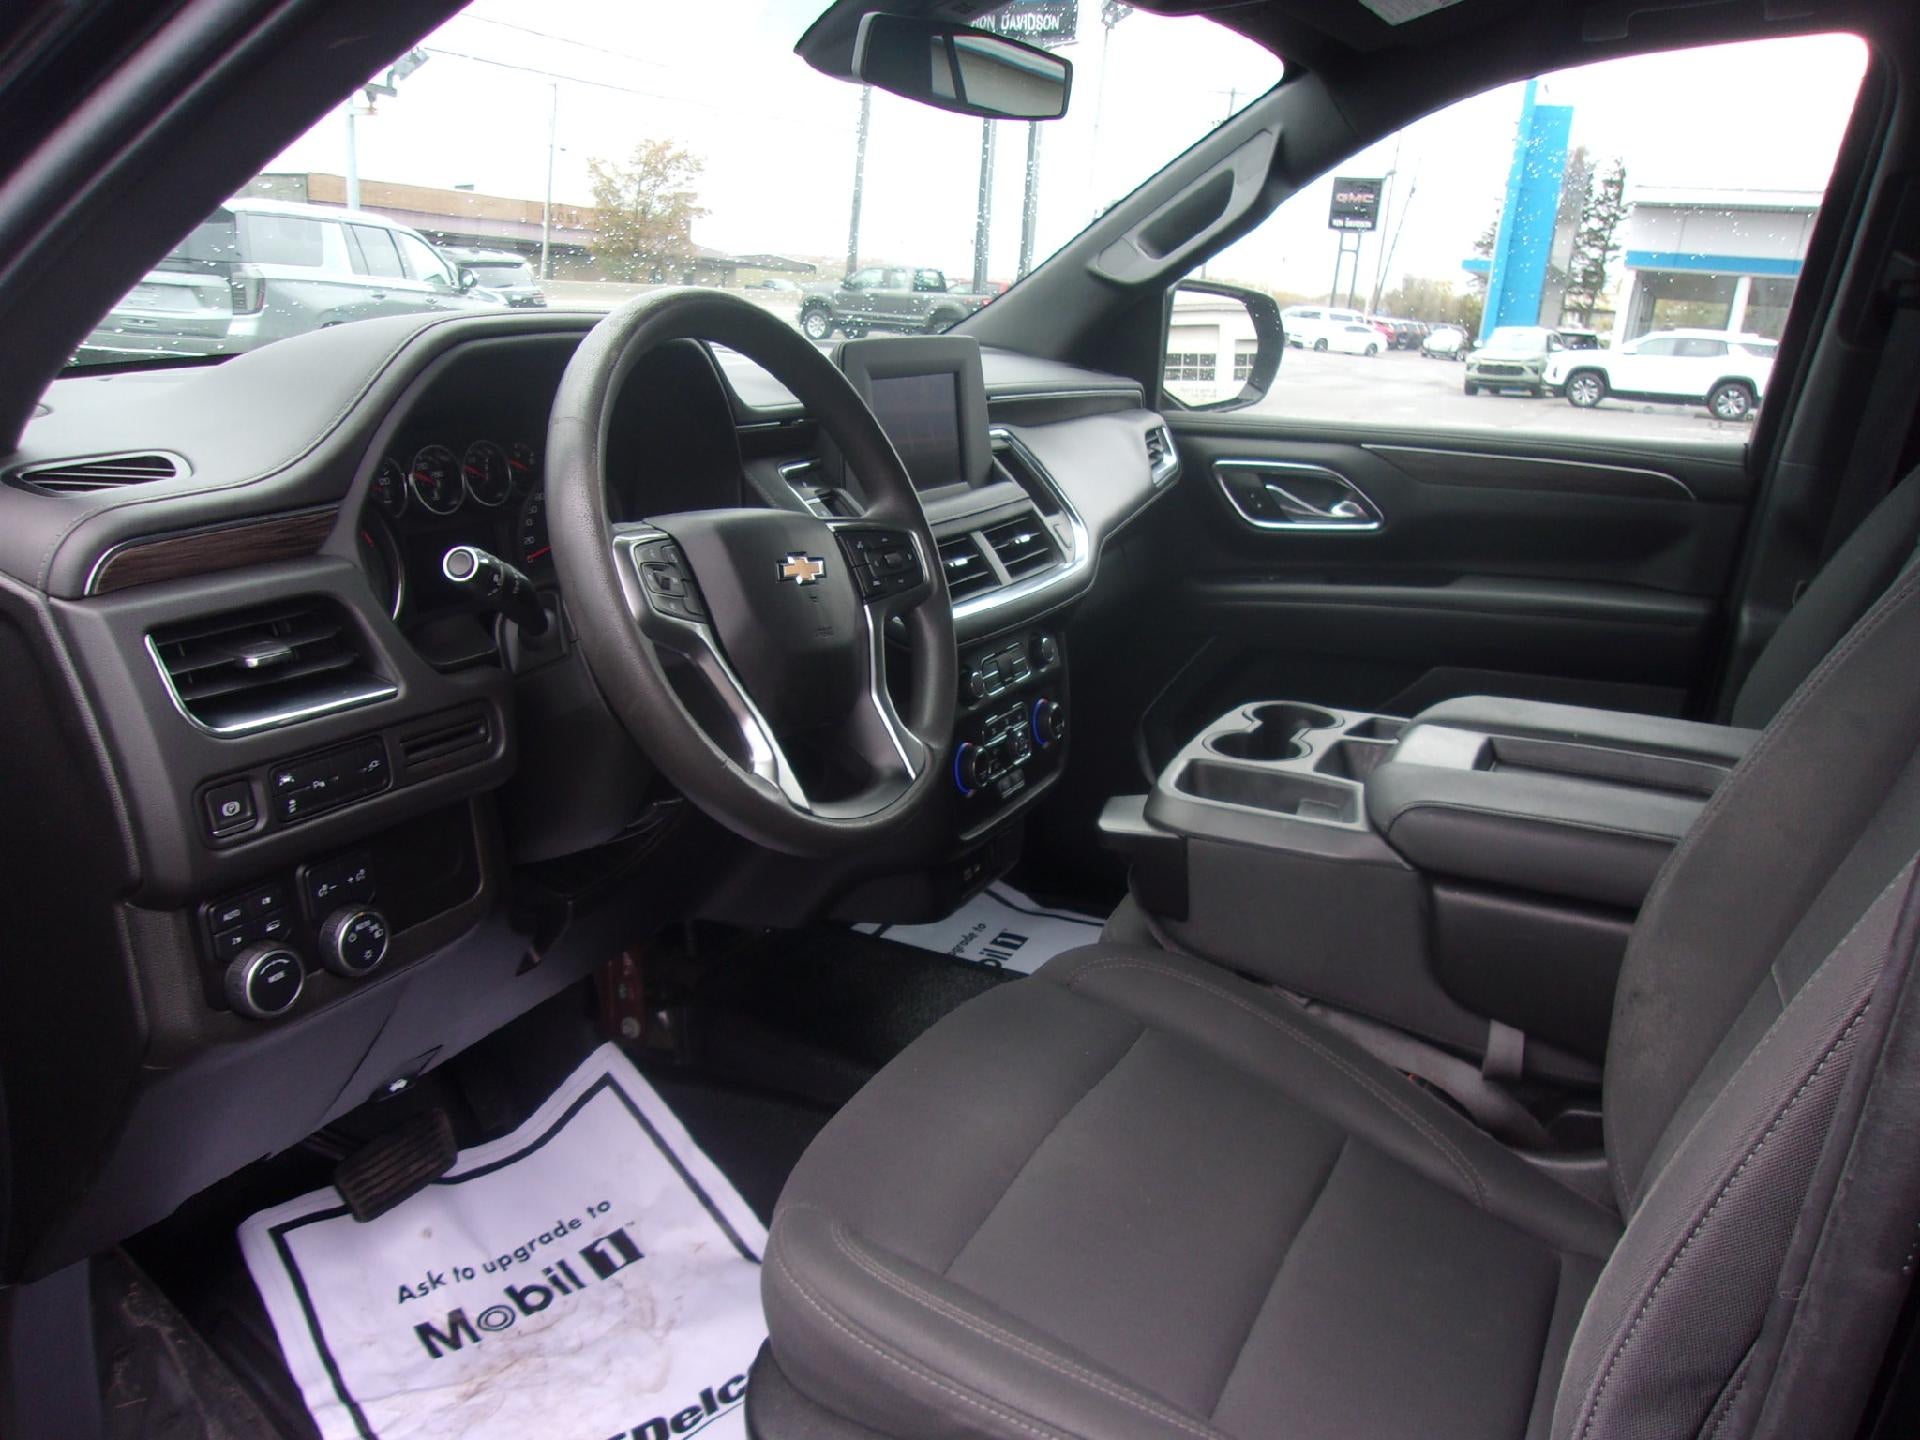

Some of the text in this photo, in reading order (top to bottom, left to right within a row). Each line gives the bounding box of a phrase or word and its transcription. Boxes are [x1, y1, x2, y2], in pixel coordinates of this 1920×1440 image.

[1000, 12, 1060, 31] DAVIDSON
[1336, 193, 1374, 203] GMC
[397, 1199, 611, 1304] Ask to upgrade to
[414, 1259, 588, 1359] Mobil
[607, 1374, 748, 1440] Delc
